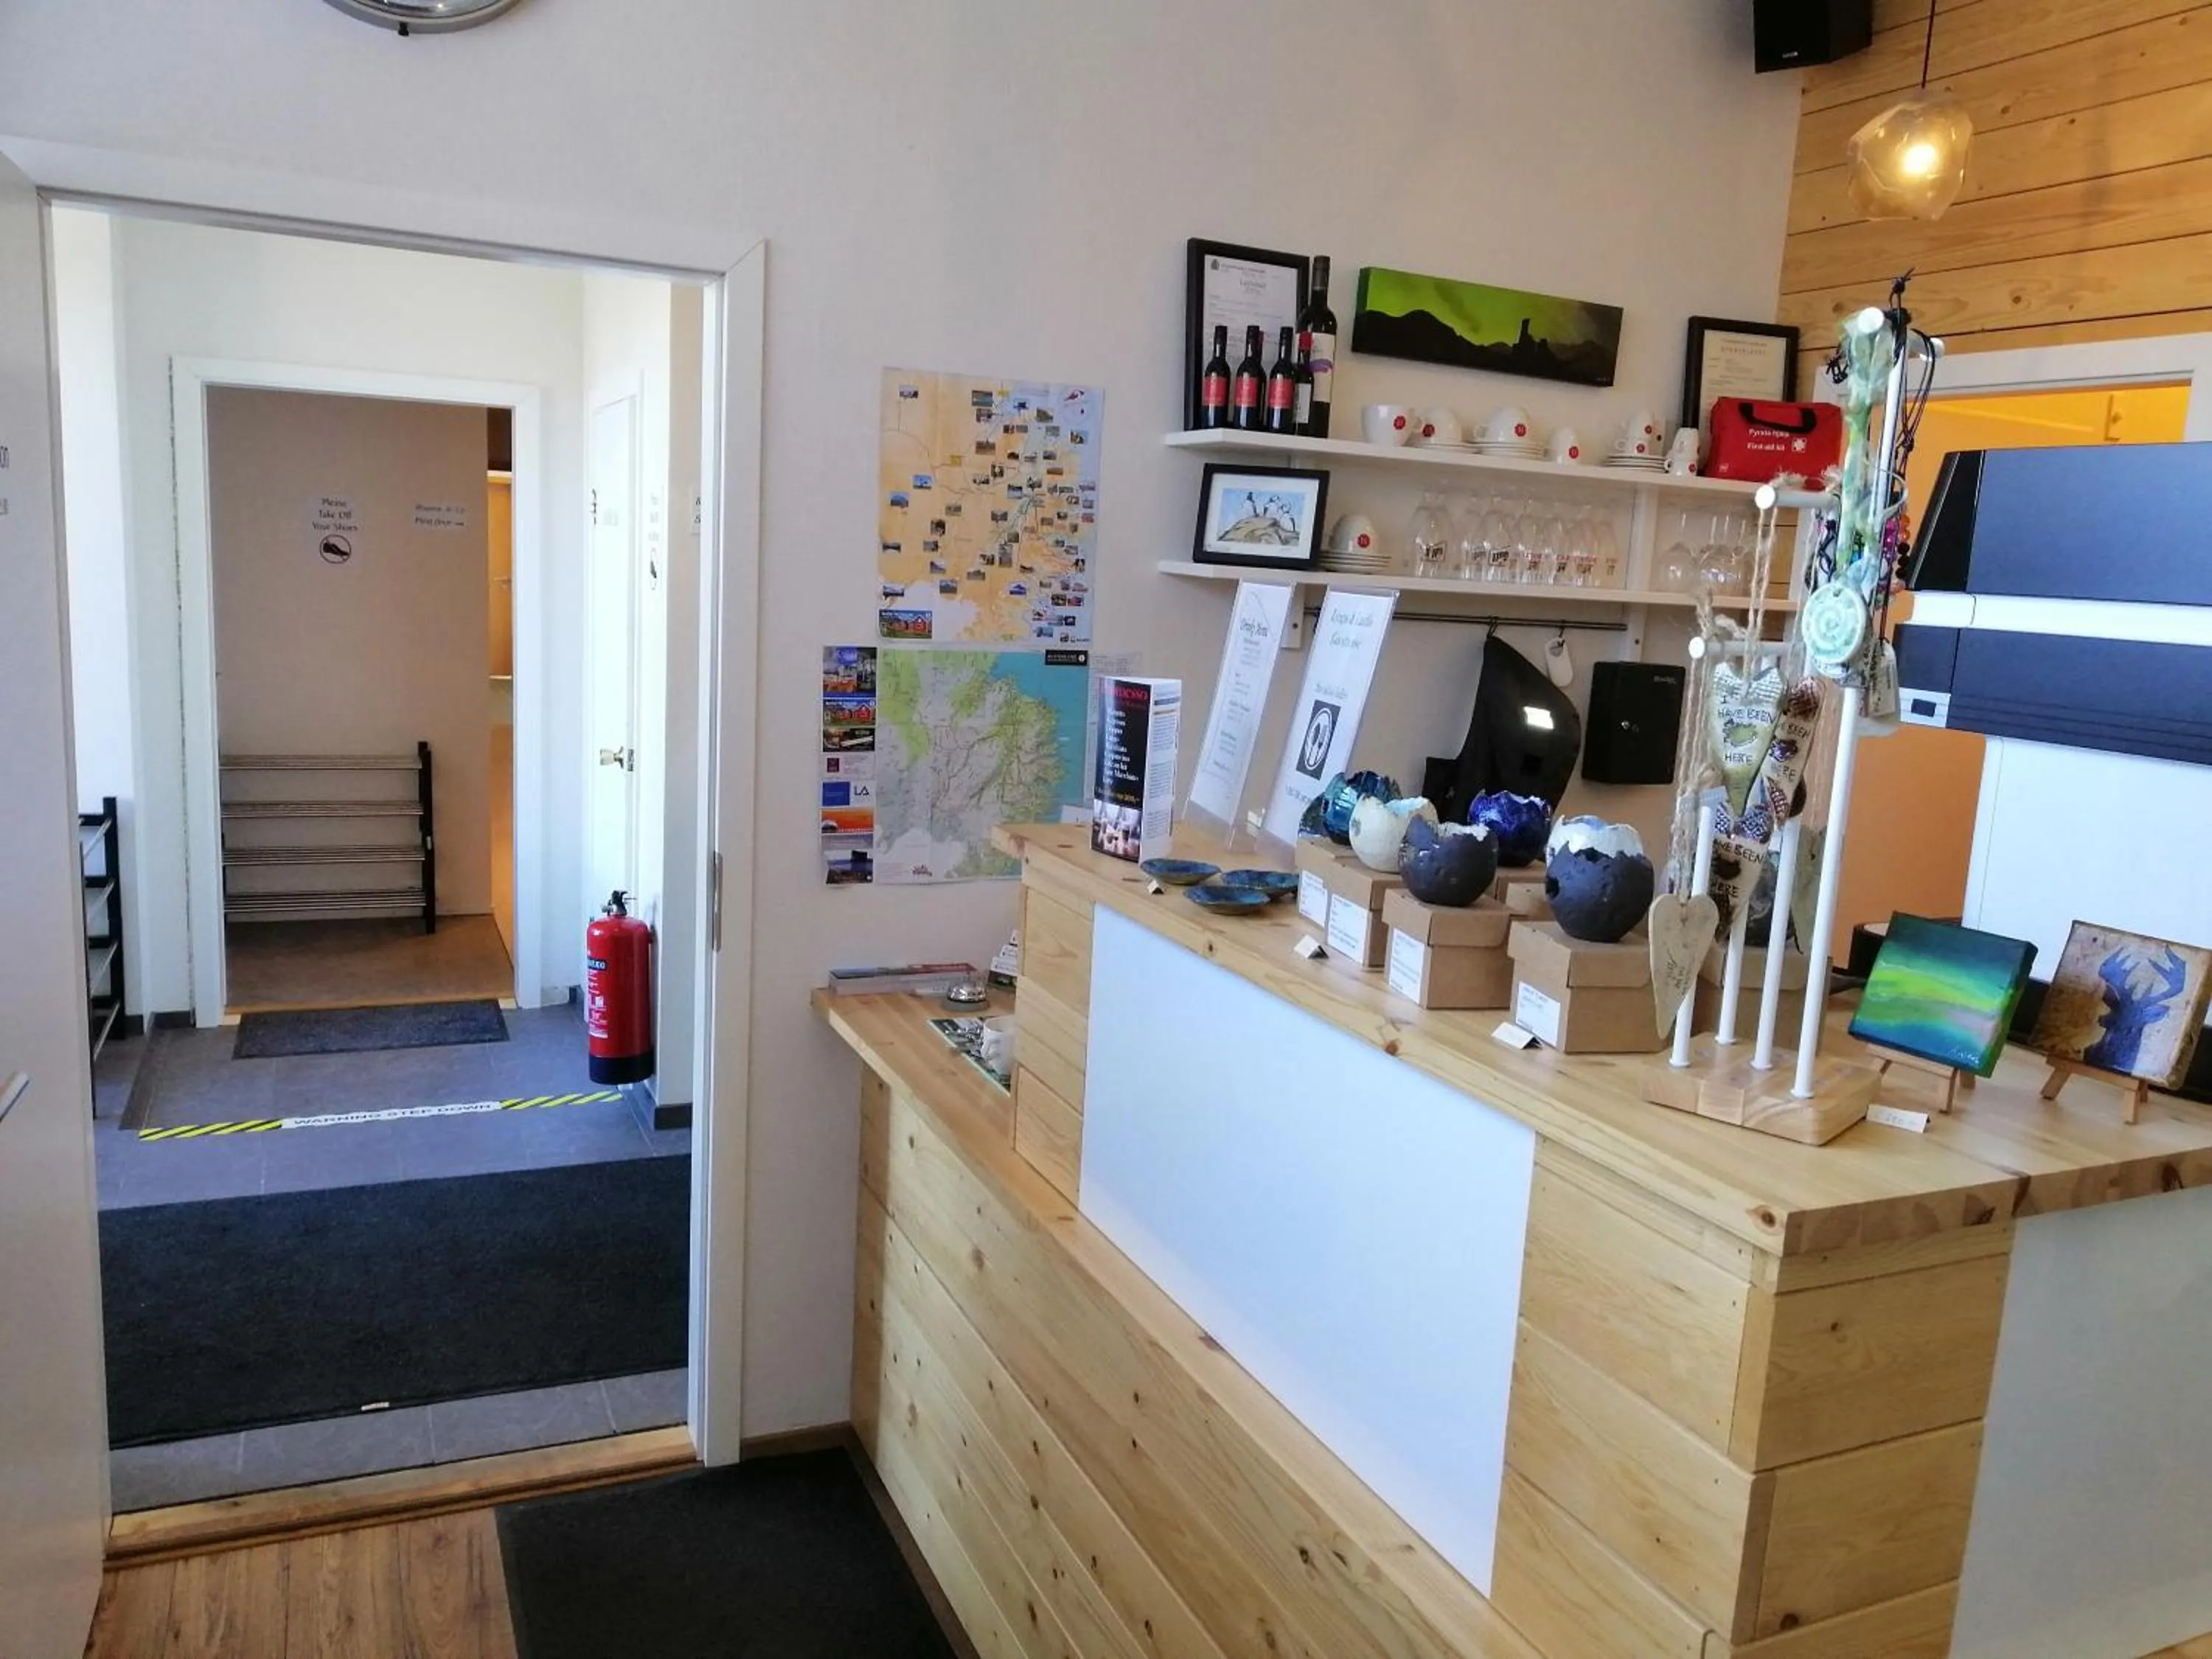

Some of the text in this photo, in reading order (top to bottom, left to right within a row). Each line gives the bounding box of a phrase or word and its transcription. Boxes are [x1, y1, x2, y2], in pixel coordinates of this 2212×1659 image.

[321, 498, 347, 507] Please
[319, 509, 352, 520] Take Off
[312, 521, 359, 531] Your Shoes
[1717, 708, 1777, 724] HAVE BEEN
[1725, 751, 1754, 765] HERE
[1733, 843, 1766, 864] BEEN
[294, 1104, 491, 1124] WARNING STEP DOWN
